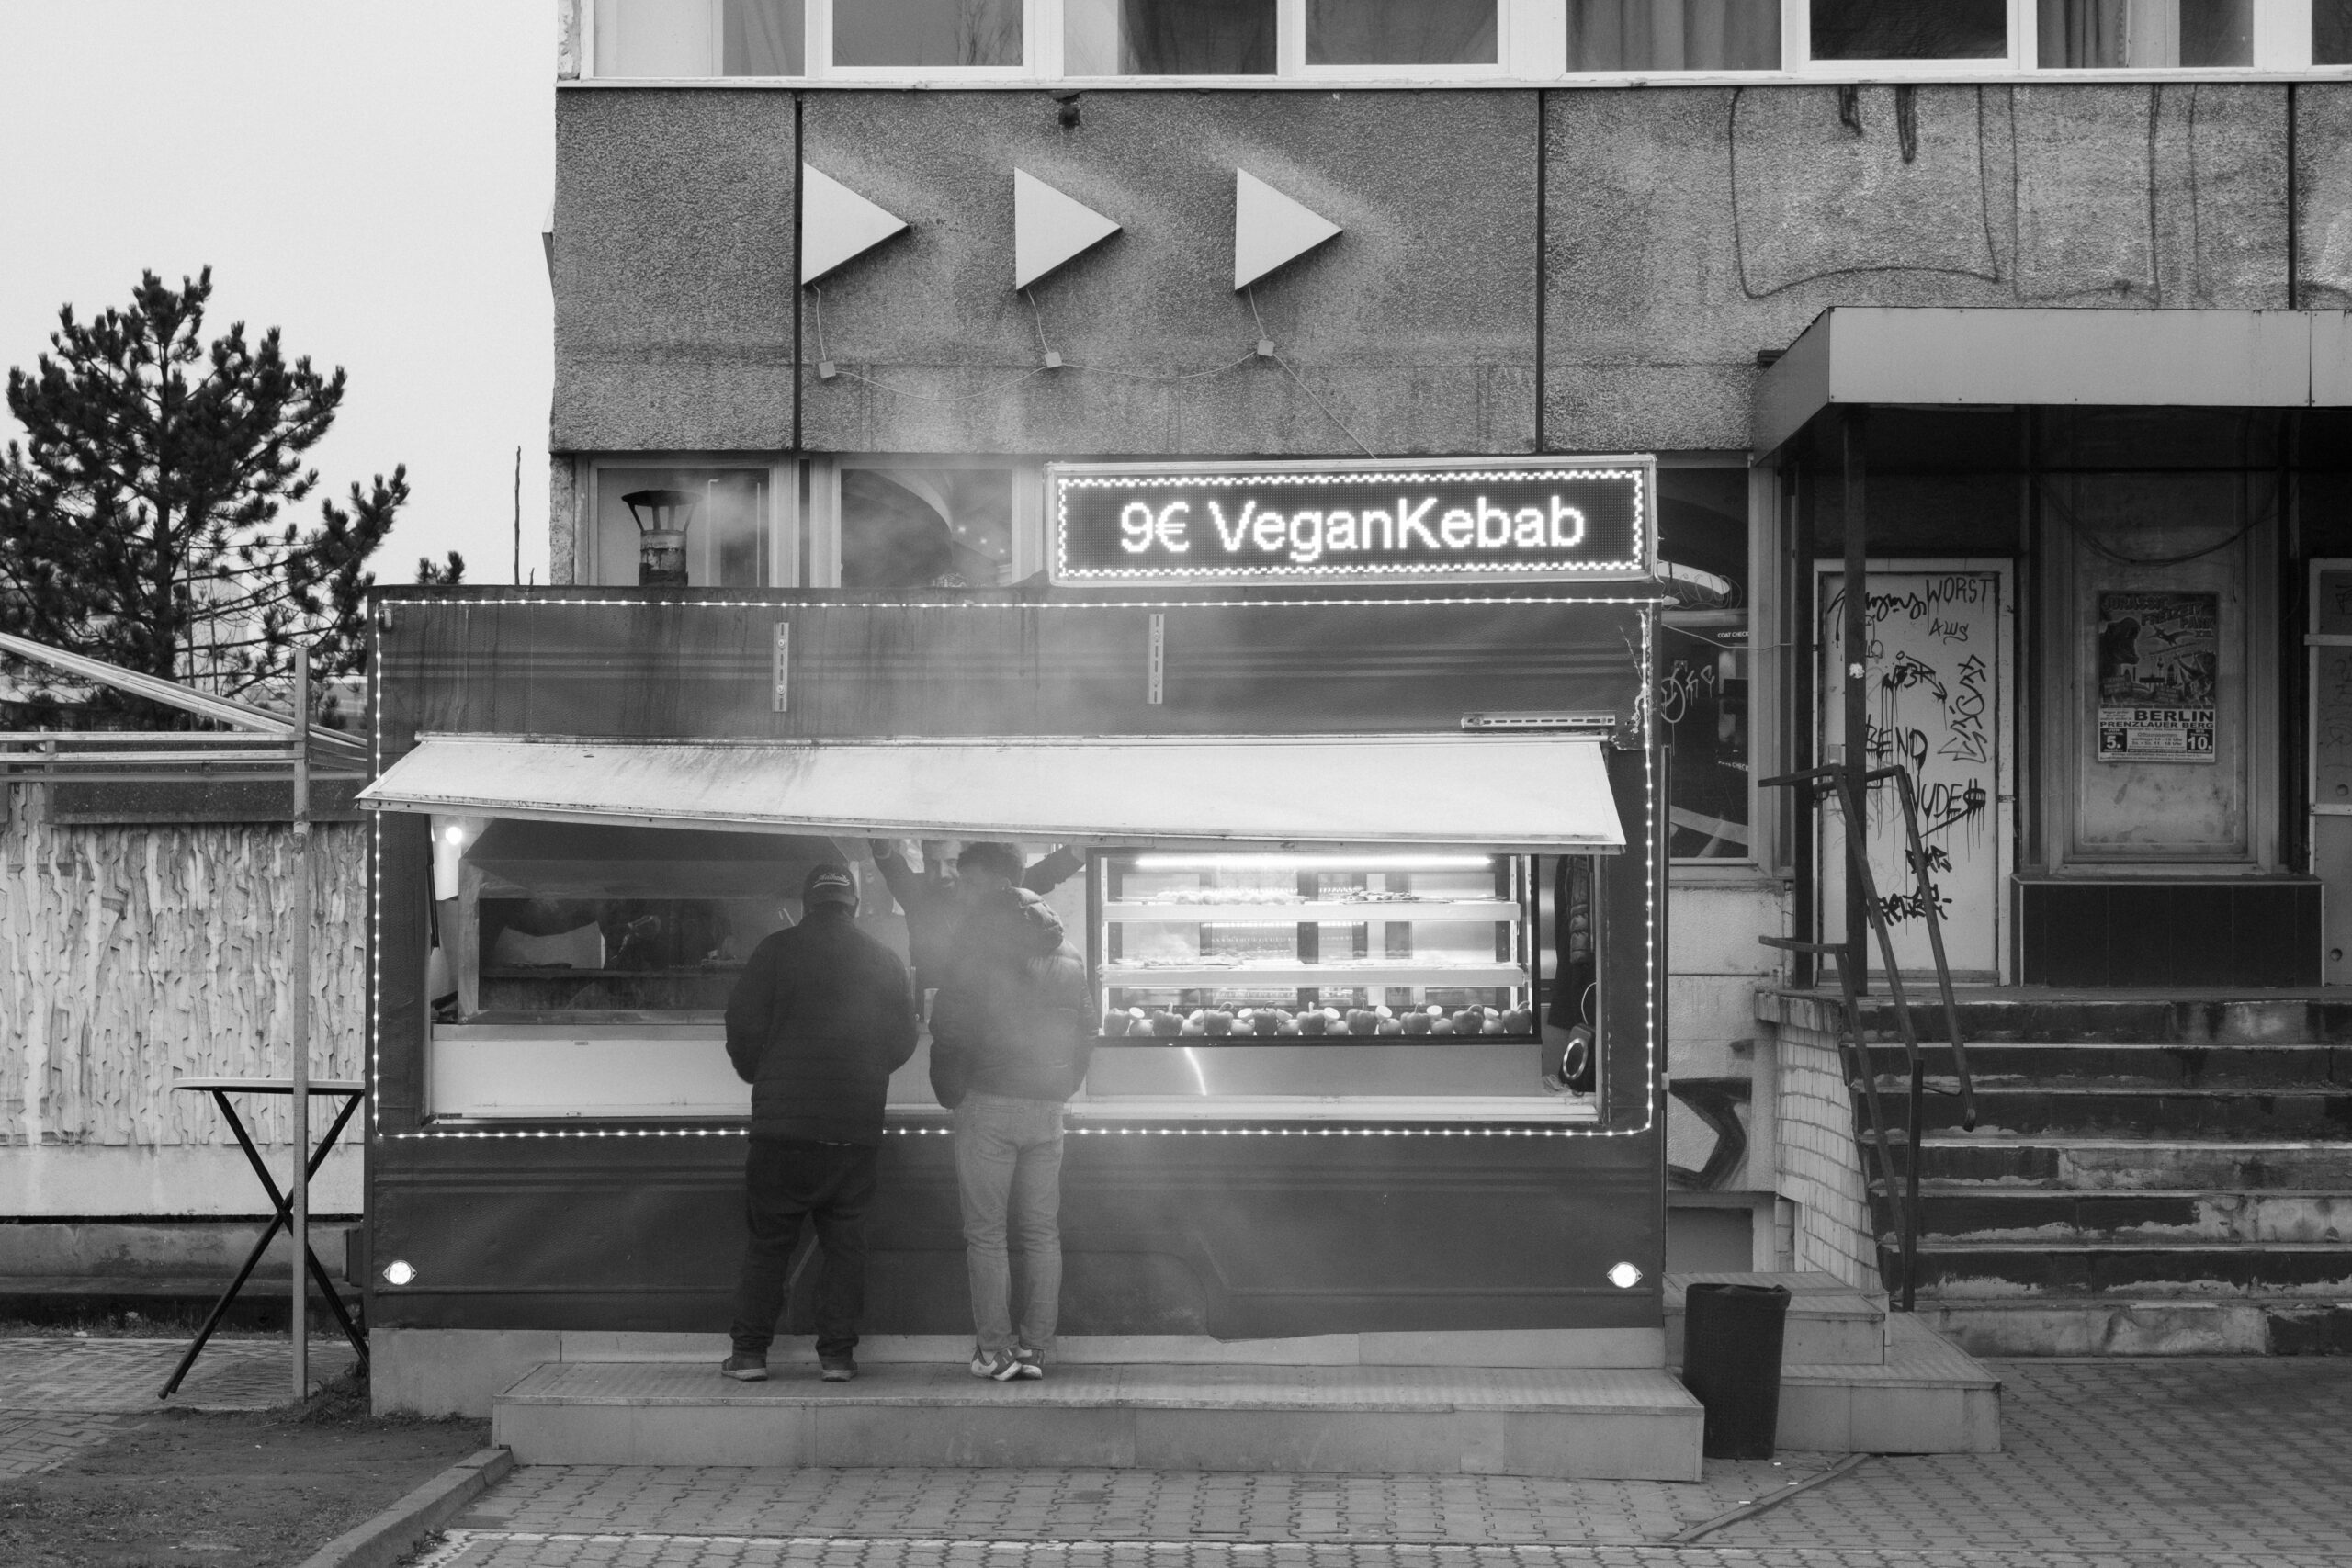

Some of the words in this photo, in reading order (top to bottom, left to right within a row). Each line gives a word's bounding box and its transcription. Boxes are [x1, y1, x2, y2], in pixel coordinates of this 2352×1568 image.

[1120, 499, 1190, 553] 9€
[1208, 494, 1586, 563] VeganKebab
[1926, 577, 1994, 604] WORST
[2134, 710, 2214, 722] BERLIN
[2106, 735, 2121, 750] 5.
[2188, 736, 2212, 750] 10.
